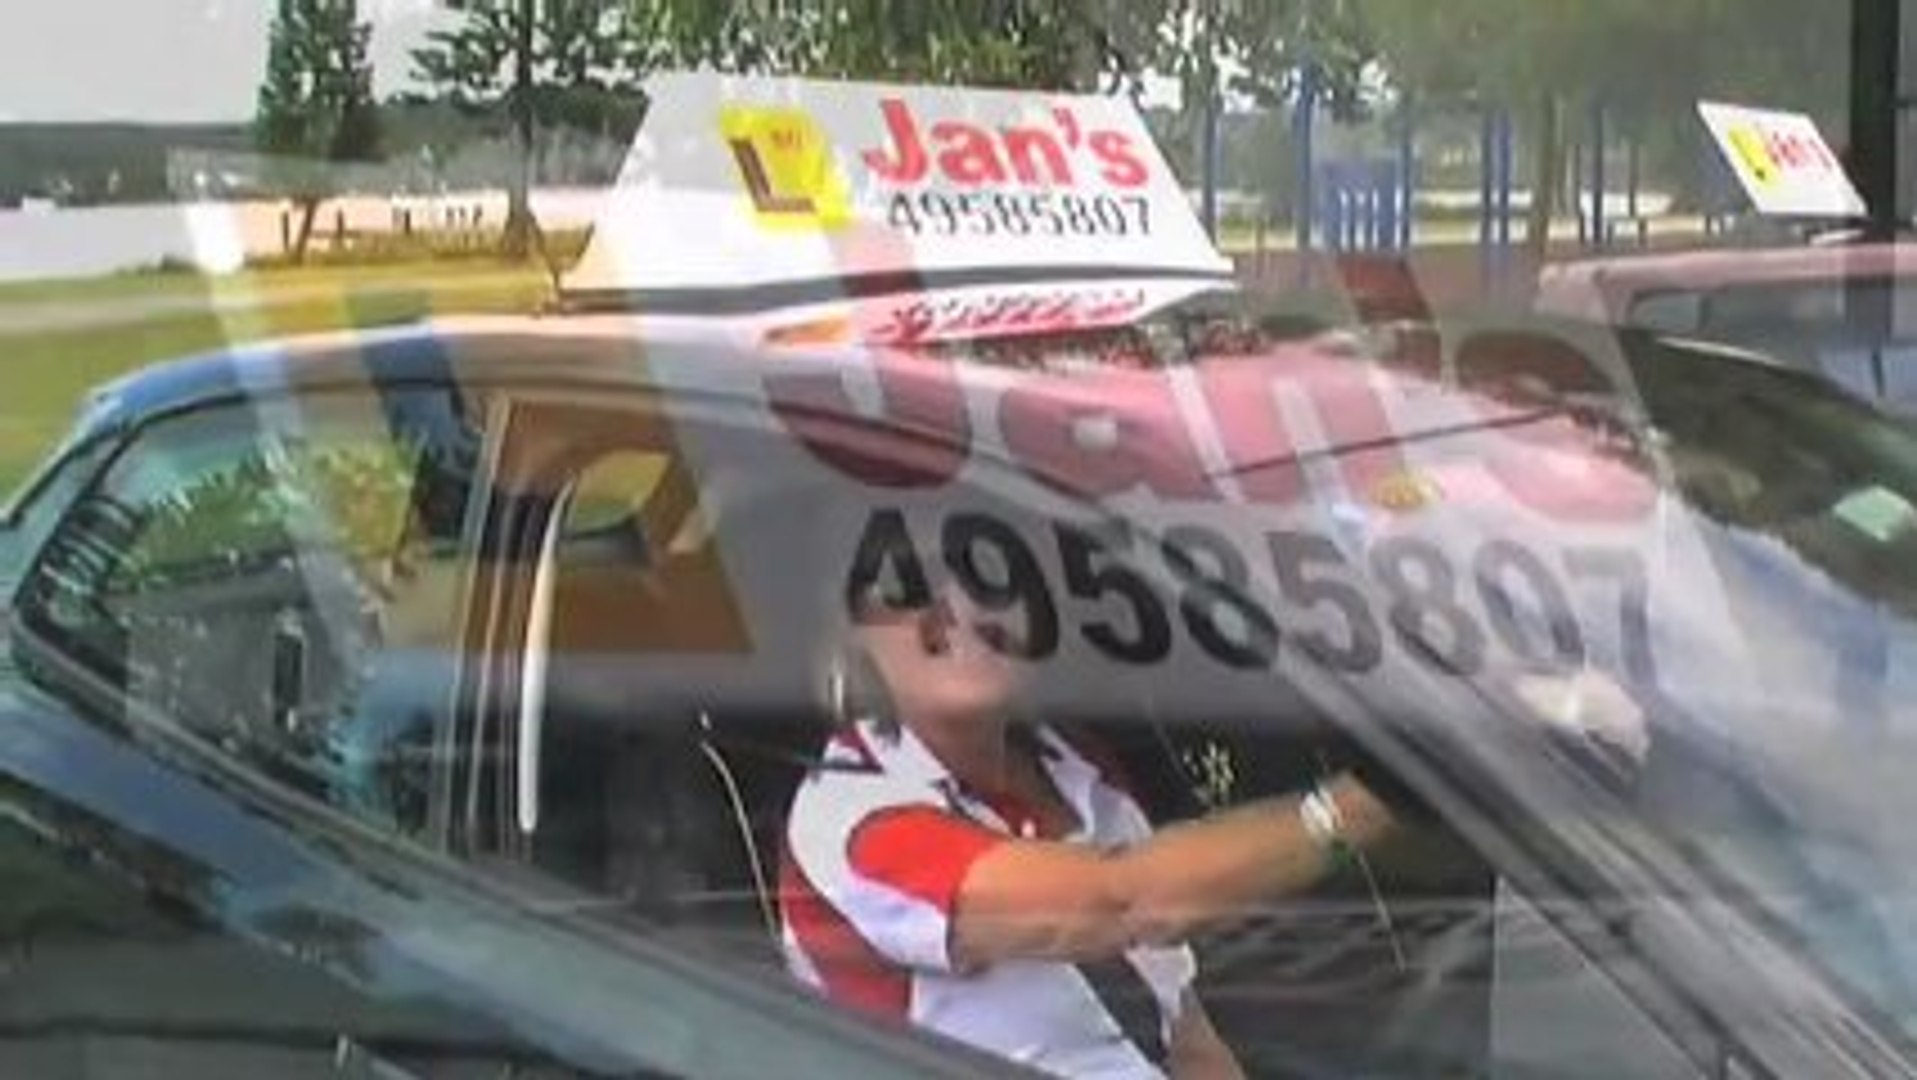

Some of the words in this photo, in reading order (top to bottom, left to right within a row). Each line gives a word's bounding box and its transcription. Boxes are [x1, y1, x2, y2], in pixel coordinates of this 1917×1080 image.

[728, 137, 817, 213] L
[863, 98, 1149, 187] Jan's
[887, 192, 1153, 236] 49585807
[845, 506, 1658, 692] 49585807
